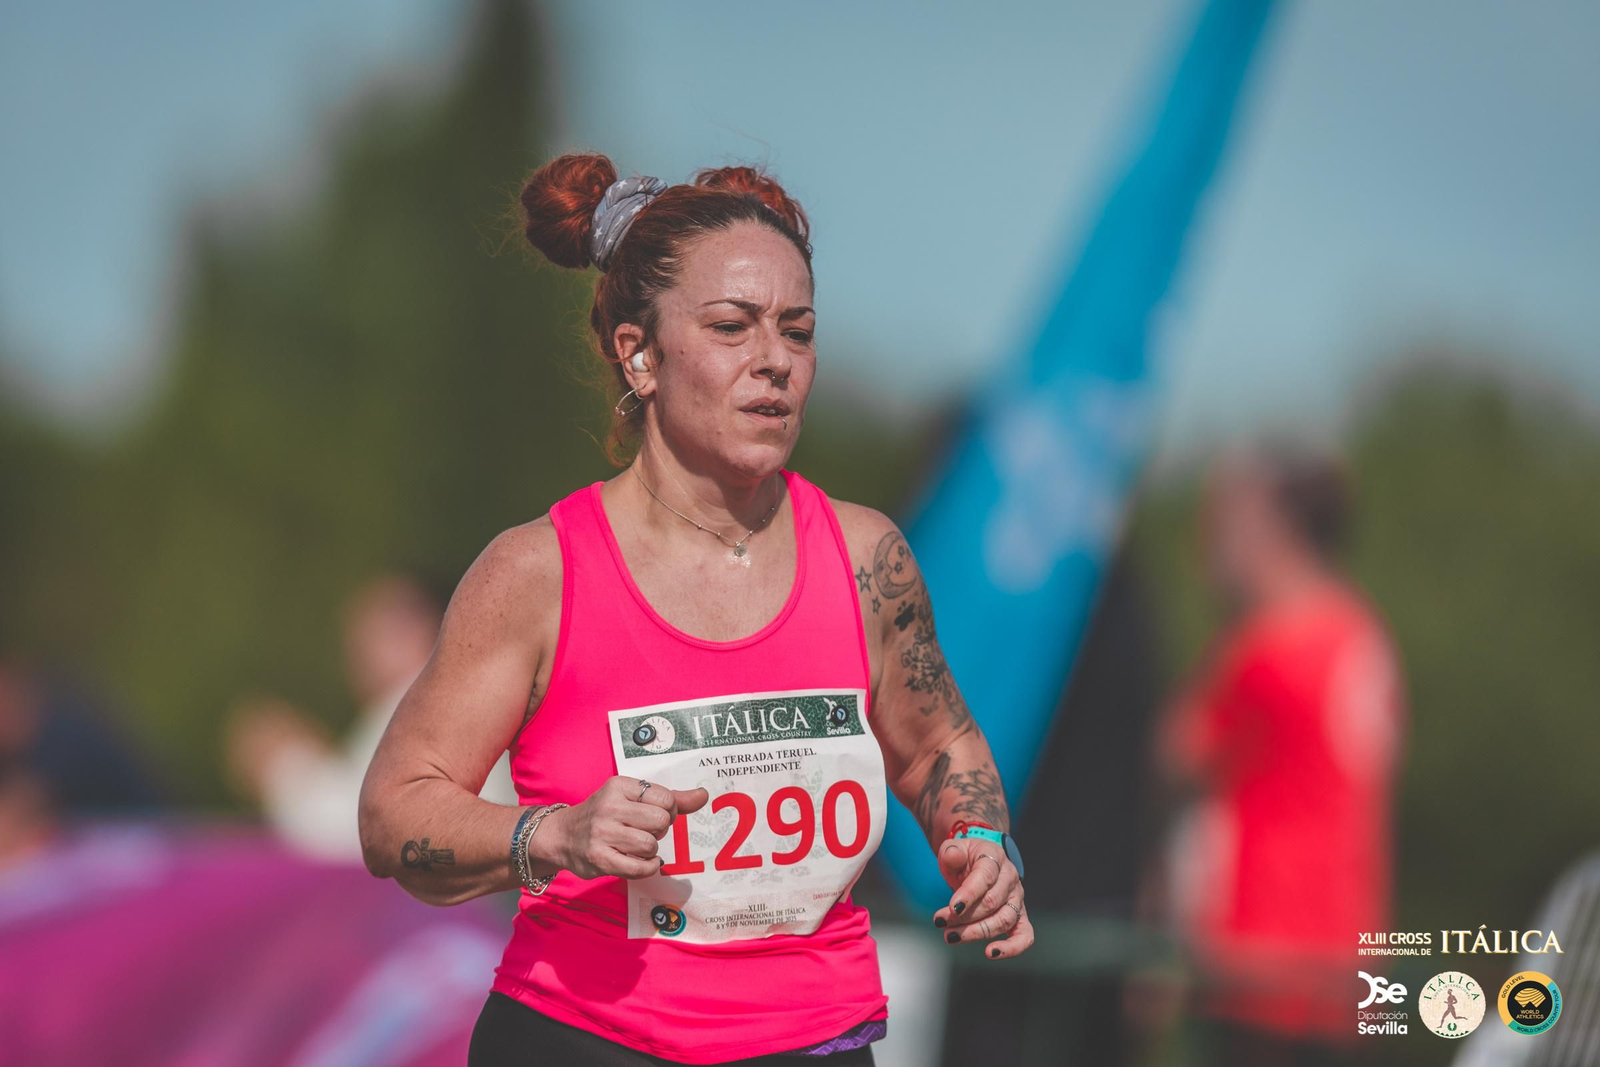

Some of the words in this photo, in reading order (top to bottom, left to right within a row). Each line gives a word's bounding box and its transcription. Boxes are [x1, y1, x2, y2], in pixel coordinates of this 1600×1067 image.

[692, 705, 811, 740] ITÁLICA
[758, 733, 779, 741] CROSS
[781, 730, 812, 739] COUNTRY
[698, 757, 720, 767] ANA
[723, 752, 774, 765] TERRADA
[775, 747, 817, 759] TERUEL
[717, 761, 802, 778] INDEPENDIENTE
[659, 780, 871, 876] 1290
[705, 915, 725, 924] CROSS
[726, 910, 774, 922] INTERNACIONAL
[739, 918, 775, 927] NOVIEMBRE
